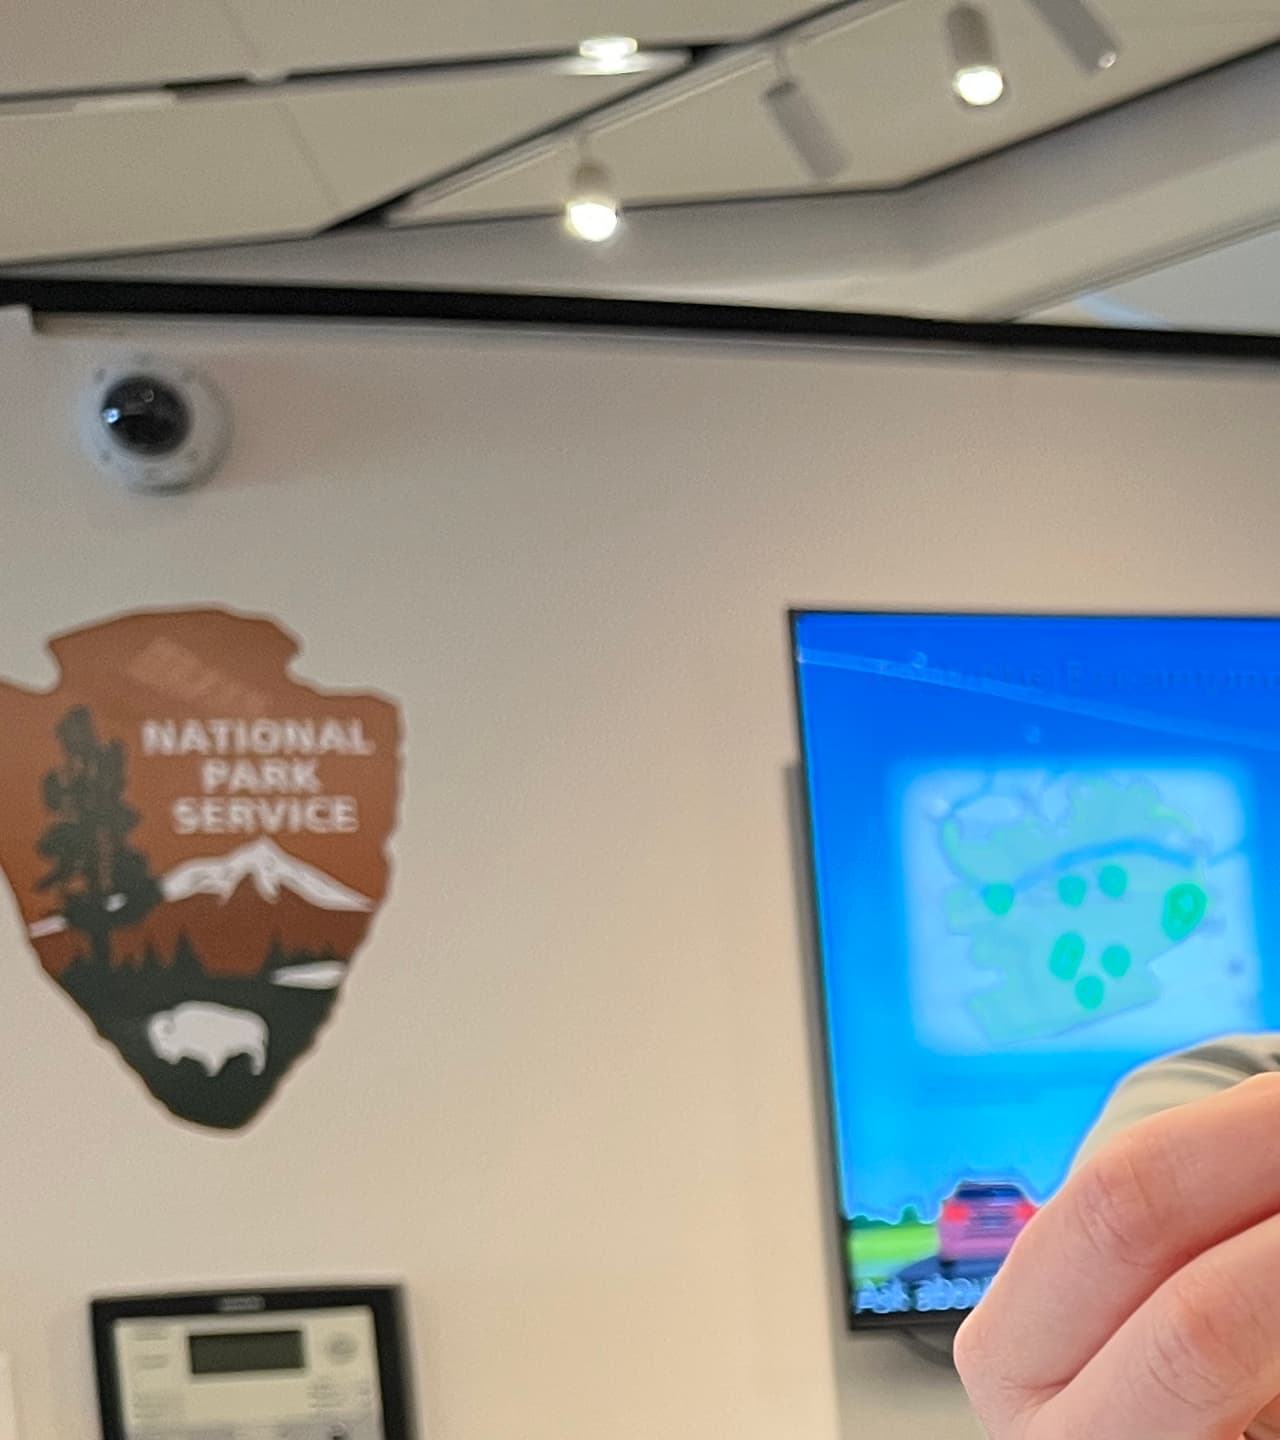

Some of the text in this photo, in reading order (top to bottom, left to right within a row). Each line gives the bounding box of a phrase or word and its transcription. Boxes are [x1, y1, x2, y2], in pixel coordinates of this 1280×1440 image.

[141, 719, 375, 756] NATIONAL
[203, 757, 322, 794] PARK
[173, 796, 359, 834] SERVICE
